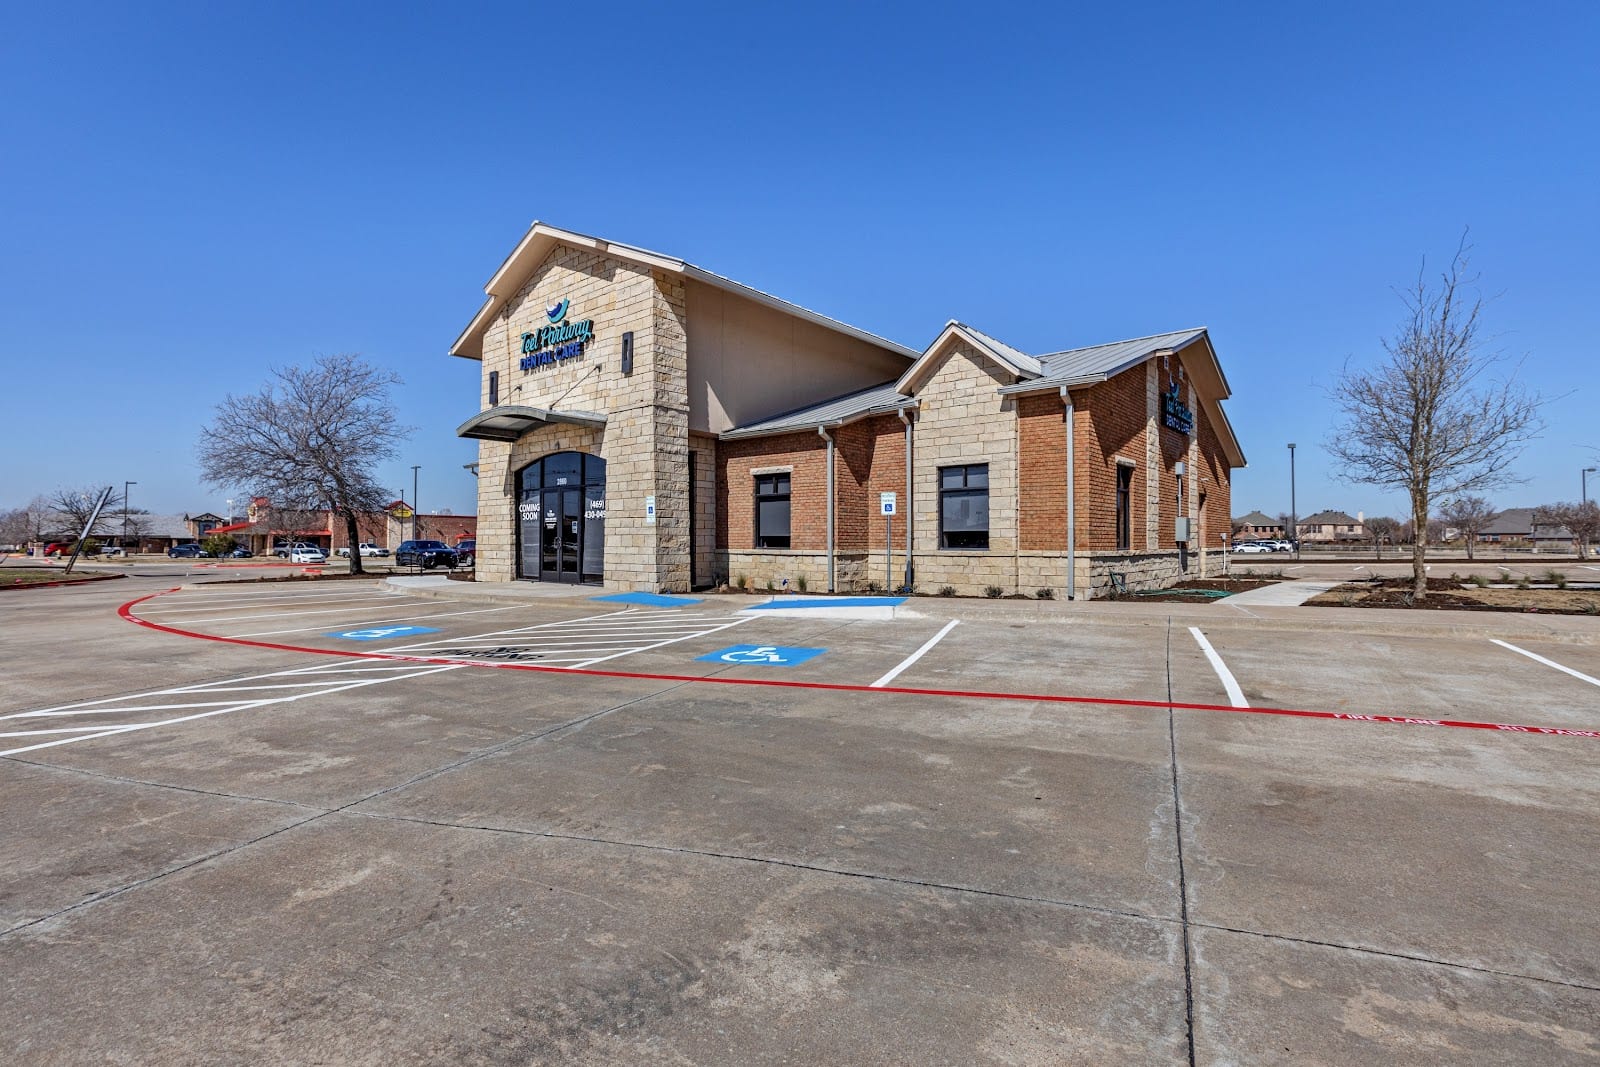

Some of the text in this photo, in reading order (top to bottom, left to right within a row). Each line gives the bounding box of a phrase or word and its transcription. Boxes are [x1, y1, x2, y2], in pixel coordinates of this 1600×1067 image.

[521, 319, 593, 353] Teel Parkway
[519, 342, 582, 370] DENTAL CARE
[518, 503, 540, 512] COMING
[522, 511, 538, 520] SOON
